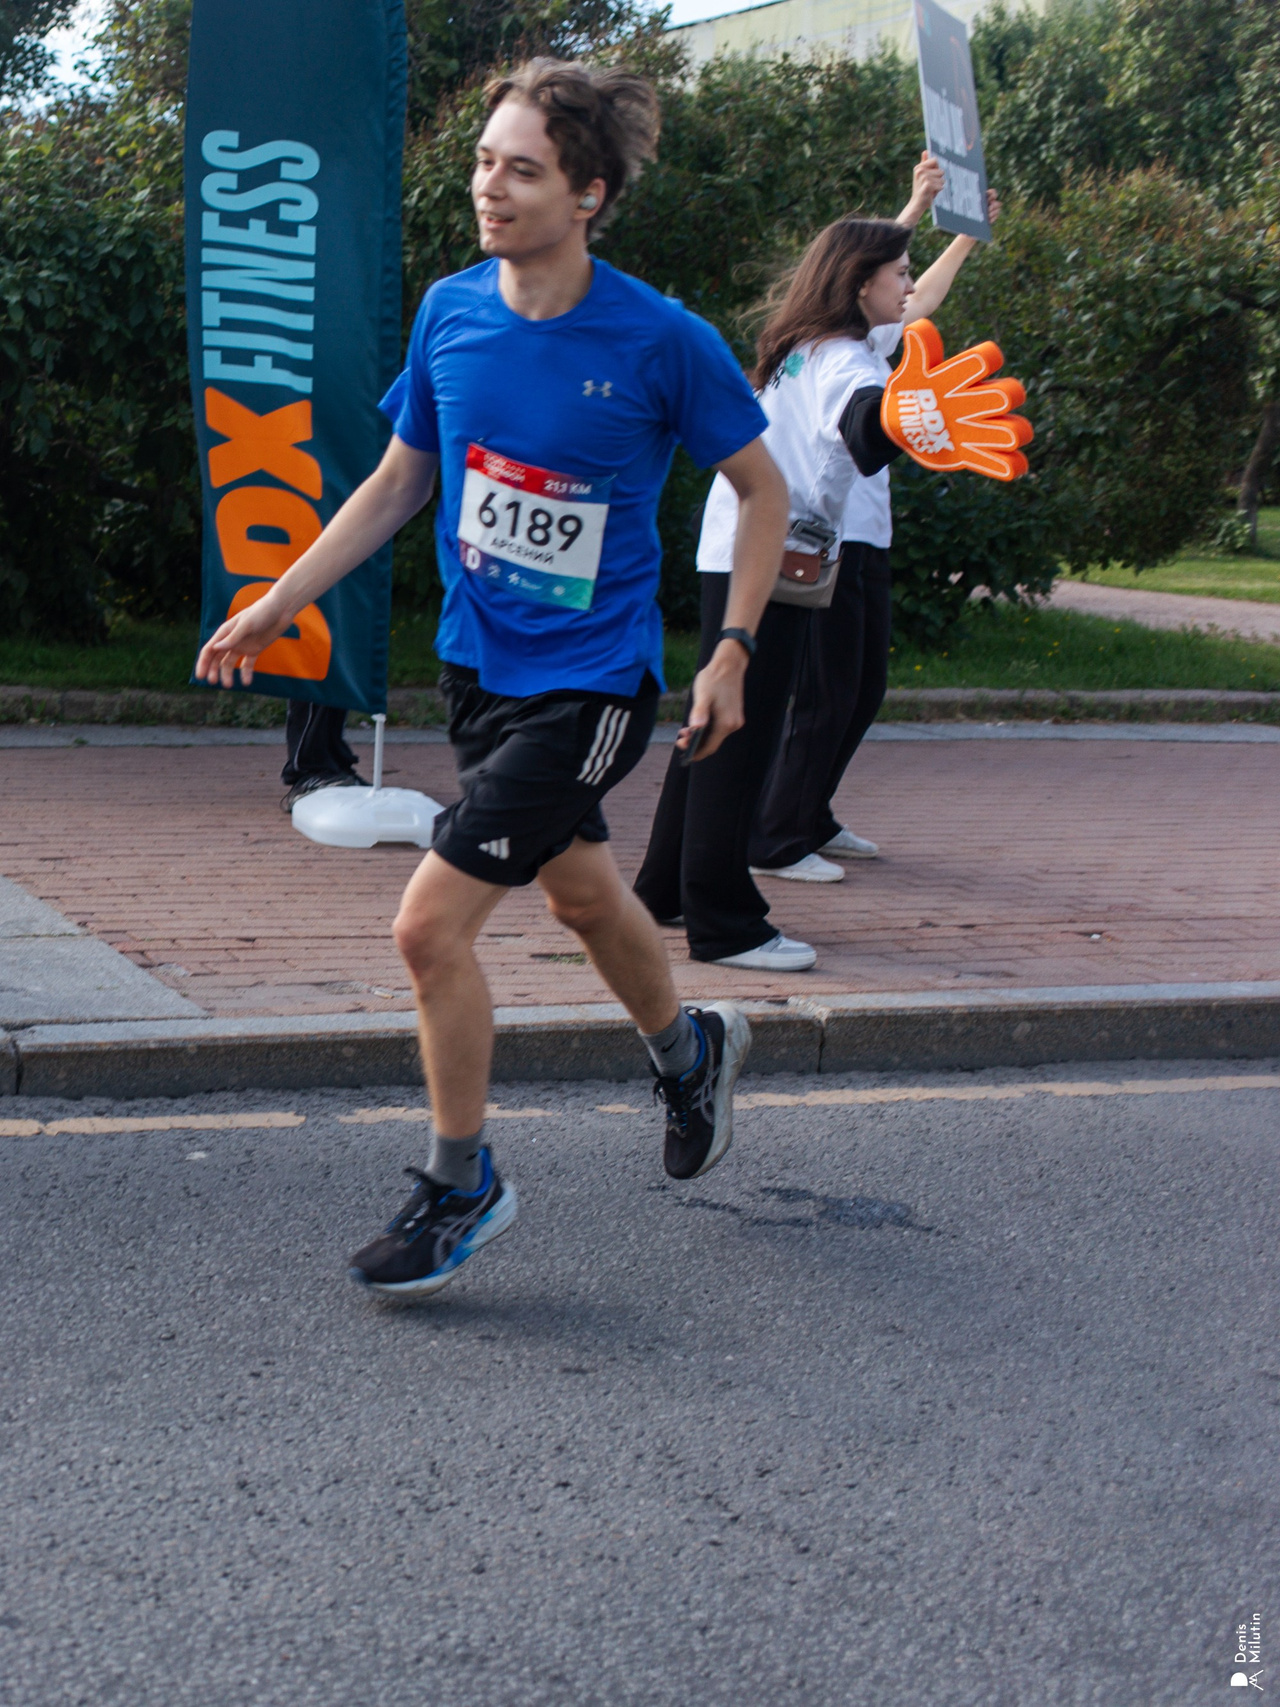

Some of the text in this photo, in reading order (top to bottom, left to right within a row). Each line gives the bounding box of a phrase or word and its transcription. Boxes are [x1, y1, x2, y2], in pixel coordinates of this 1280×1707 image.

[200, 130, 320, 393] FITNESS
[897, 389, 936, 454] FITNESS
[917, 389, 955, 454] DDX
[478, 491, 583, 551] 6189
[490, 538, 555, 565] АРСЕНИЙ
